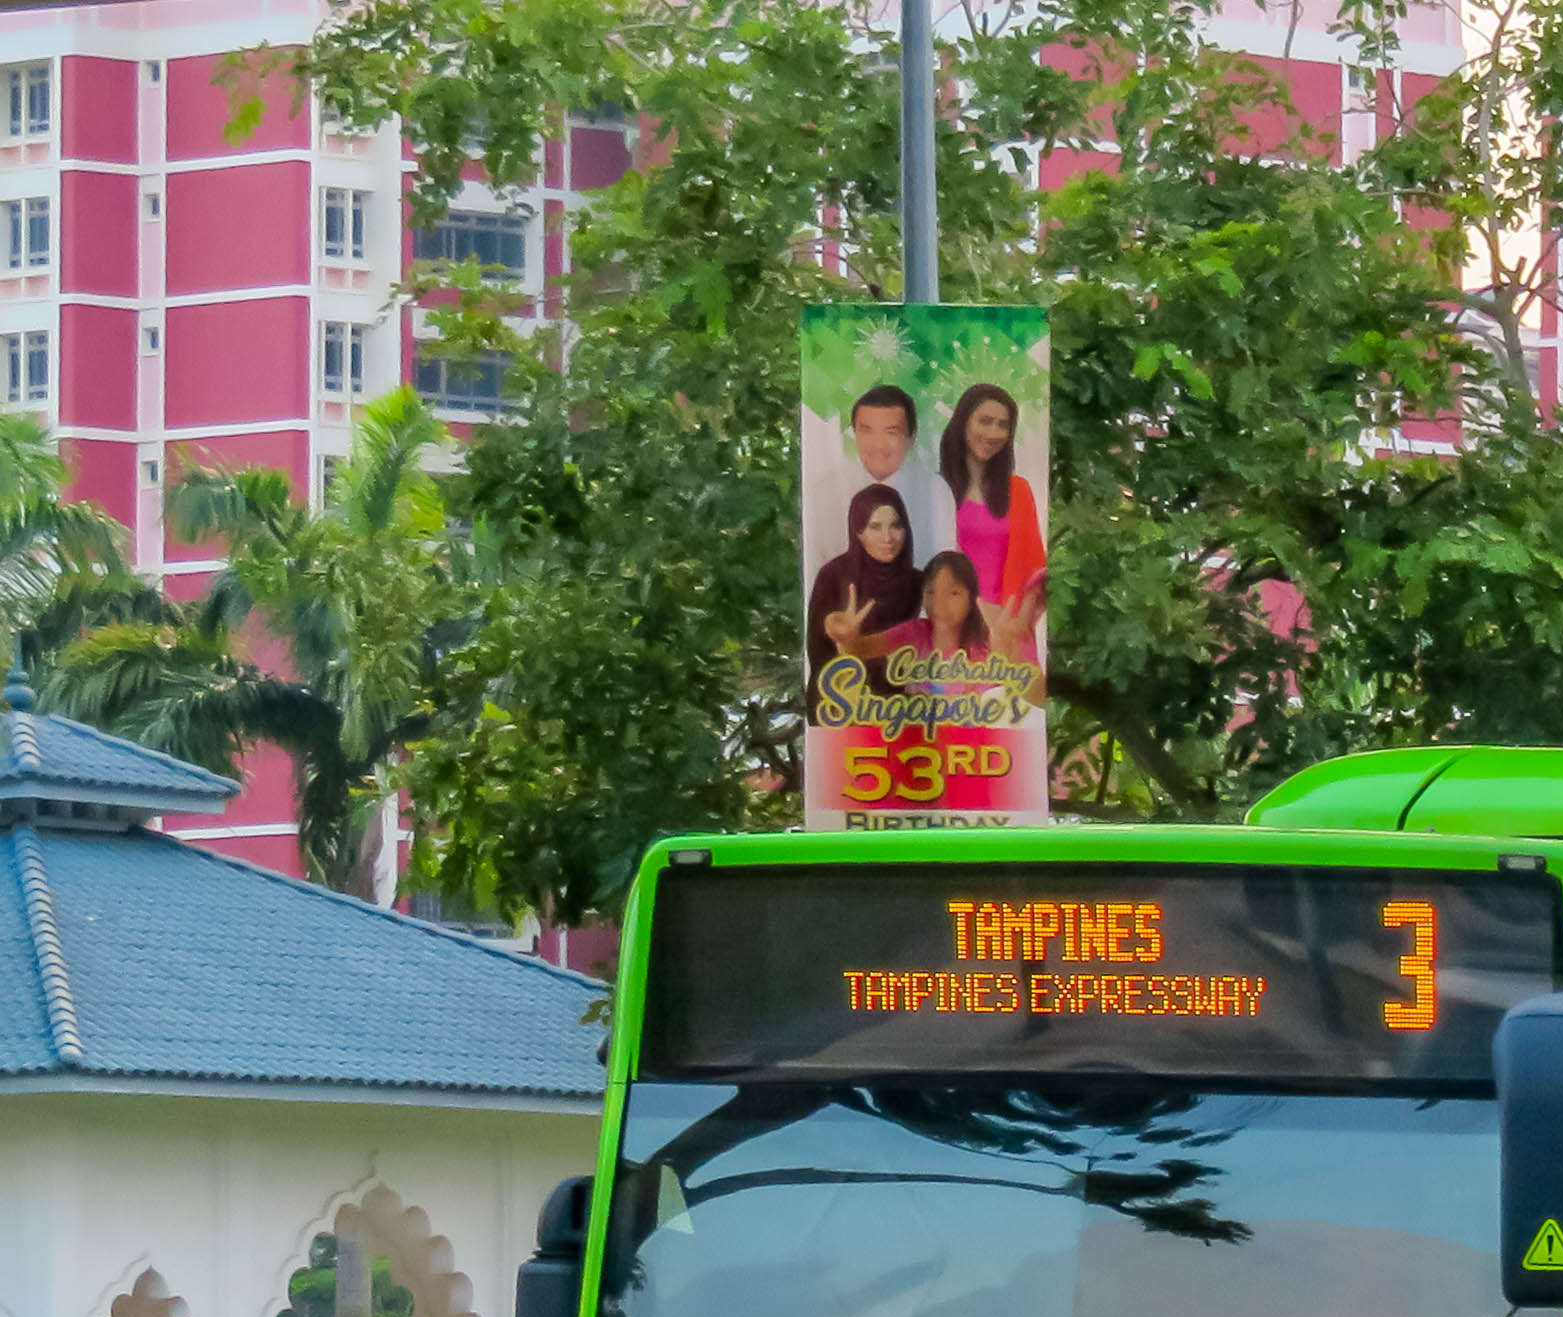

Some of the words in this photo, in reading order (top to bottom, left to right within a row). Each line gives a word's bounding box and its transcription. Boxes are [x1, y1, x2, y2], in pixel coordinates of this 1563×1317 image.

[818, 656, 1028, 741] Singapore's
[888, 646, 1035, 692] Celebrating
[948, 901, 1164, 963] TAMPINES
[842, 970, 1020, 1013] TAMPINES
[1029, 973, 1267, 1017] EXPRESSWAY
[1382, 900, 1436, 1031] 3
